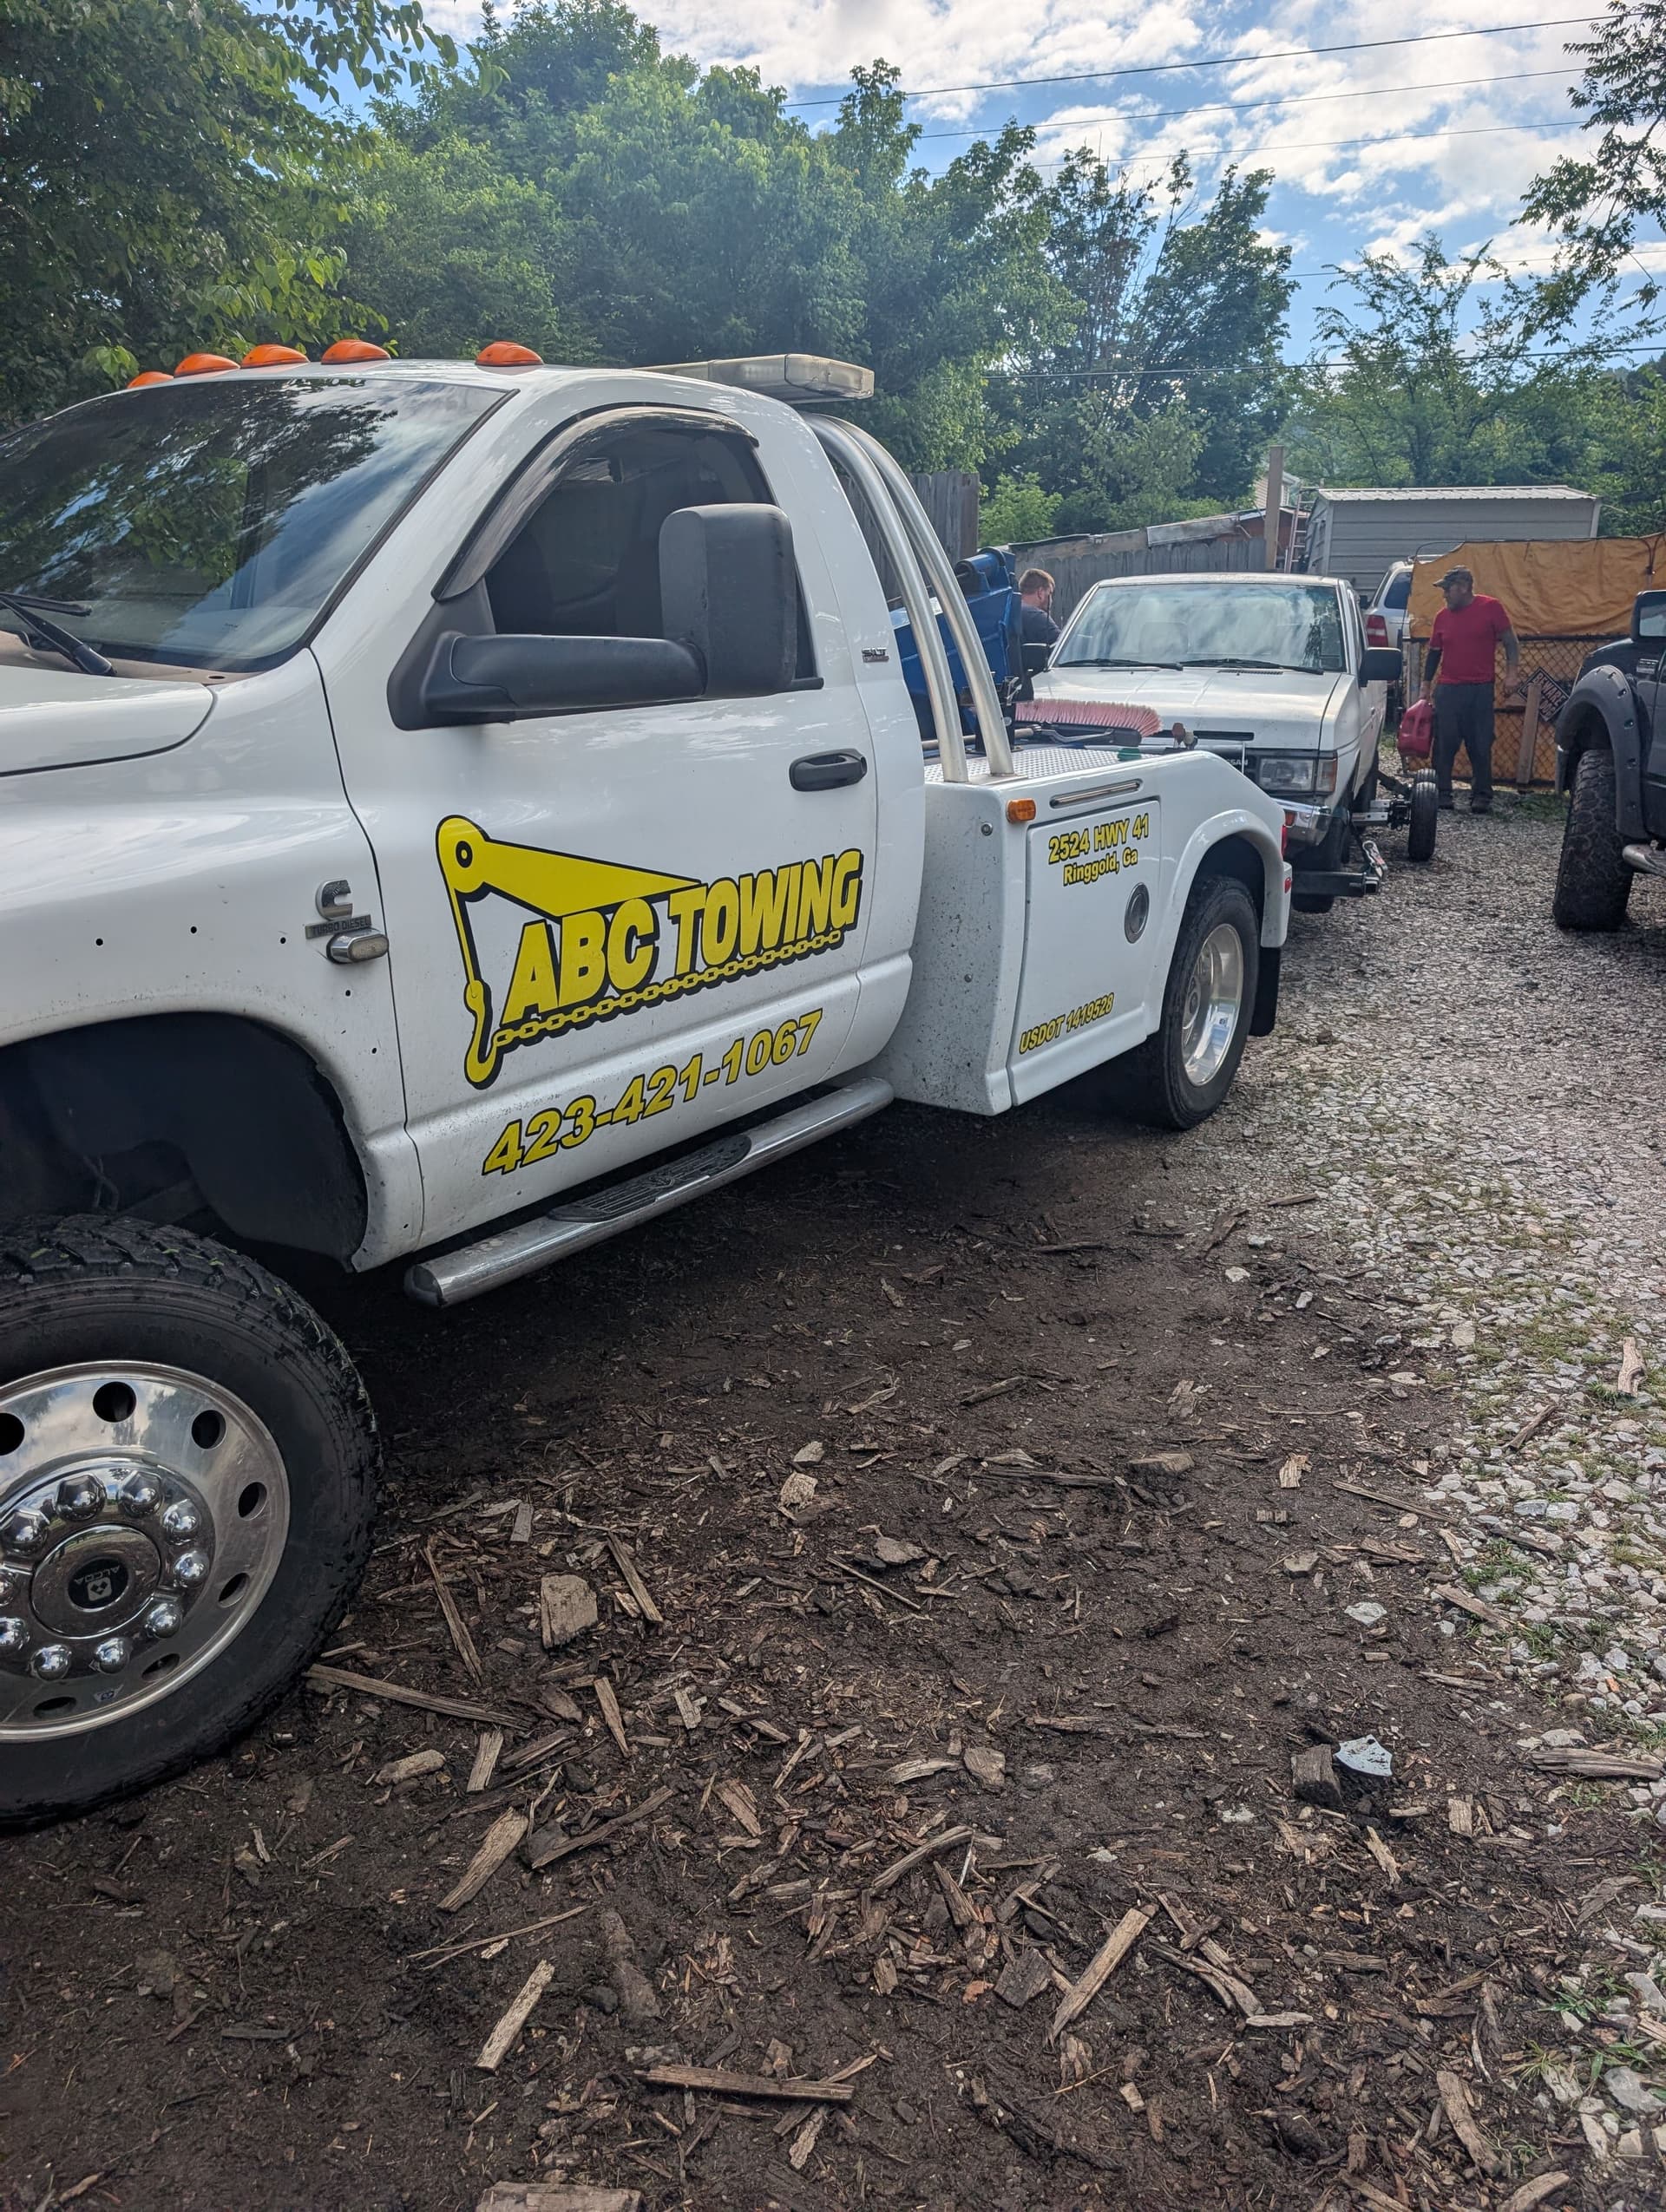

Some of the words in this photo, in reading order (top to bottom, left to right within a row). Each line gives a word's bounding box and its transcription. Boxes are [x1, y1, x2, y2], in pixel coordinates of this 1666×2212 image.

[1048, 828, 1090, 865] 2524
[1093, 818, 1130, 852] HWY
[1132, 813, 1149, 840] 41
[1063, 851, 1119, 887] Ringgold,
[1122, 847, 1138, 867] Ga
[312, 921, 340, 937] TURBO
[341, 915, 371, 932] DIESEL
[500, 897, 657, 1026] ABC
[666, 848, 863, 977] TOWING
[1019, 1013, 1066, 1055] USDOT
[1066, 992, 1114, 1033] 1419528
[482, 1009, 823, 1176] 423-421-1067
[74, 1565, 120, 1585] ALCOA
